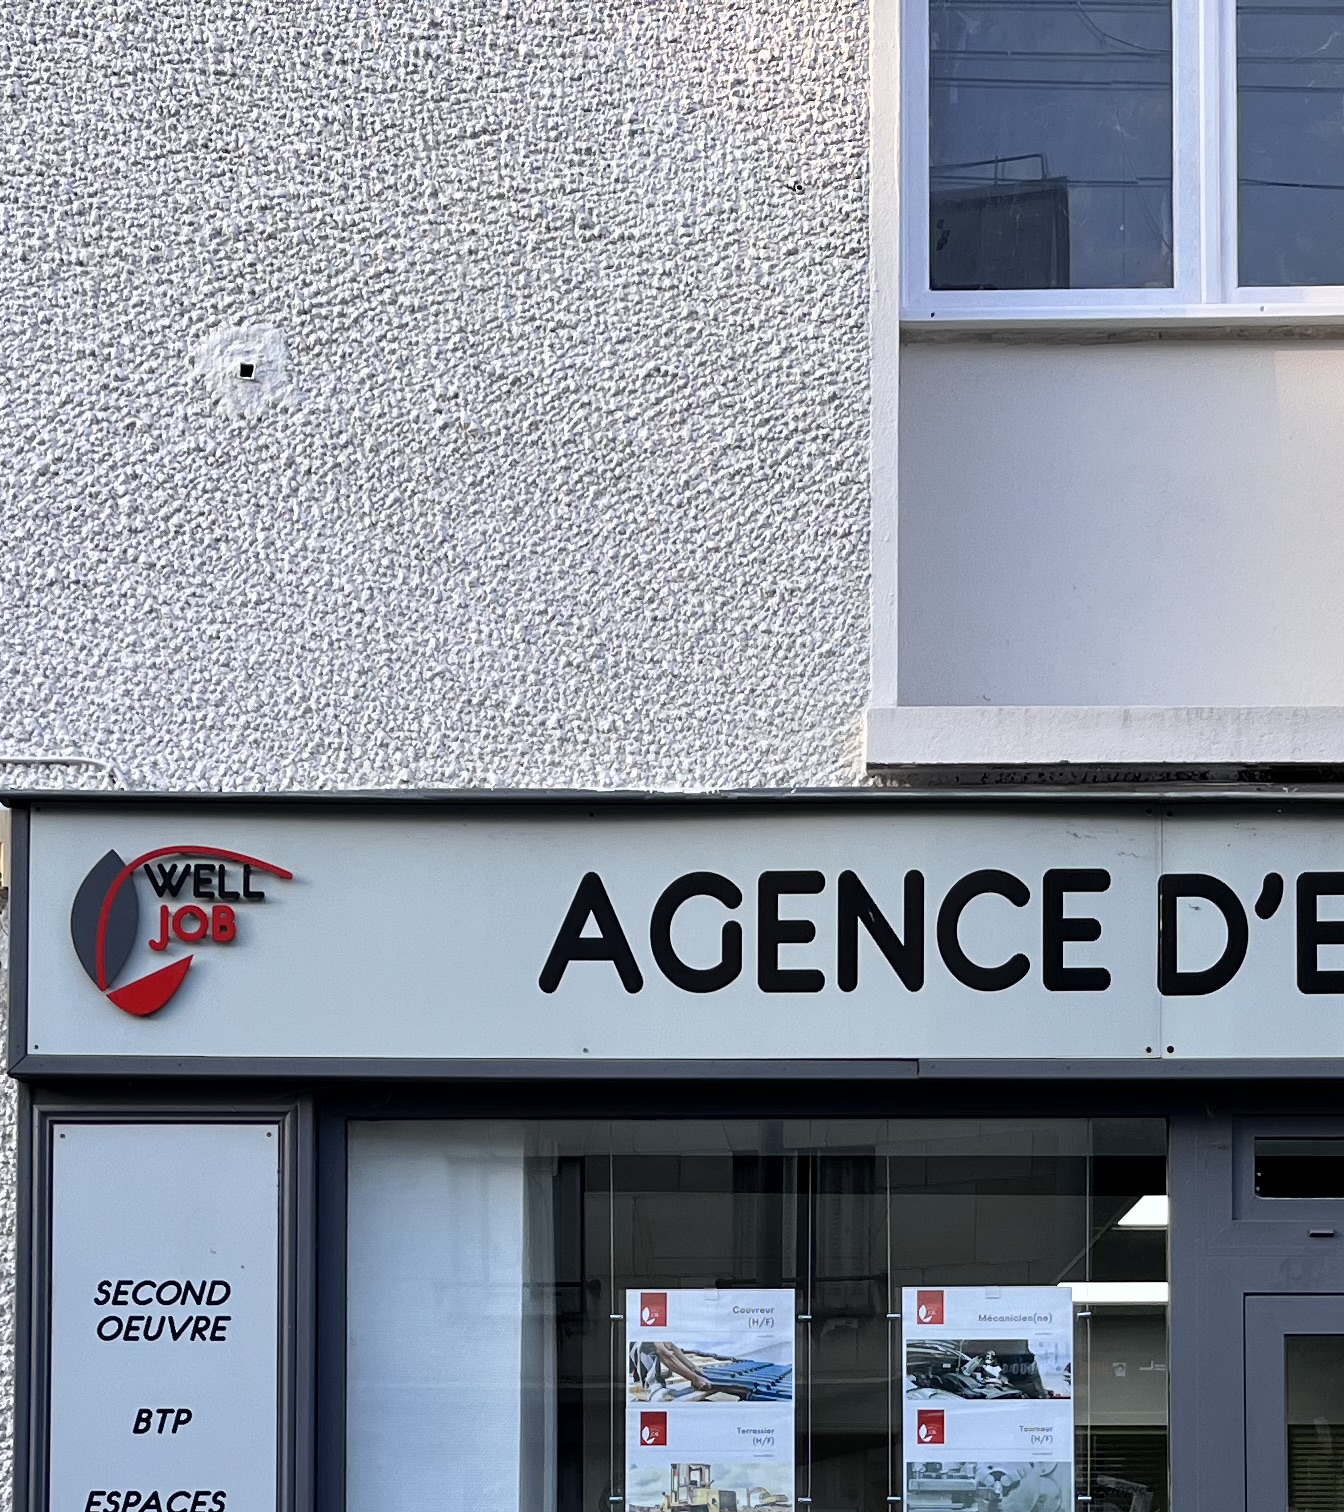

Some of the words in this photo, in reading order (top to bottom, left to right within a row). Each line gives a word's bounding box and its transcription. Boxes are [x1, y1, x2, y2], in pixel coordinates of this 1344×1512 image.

[144, 863, 265, 899] WELL
[148, 904, 237, 952] JOB
[539, 868, 1112, 994] AGENCE
[93, 1280, 232, 1307] SECOND
[732, 1306, 775, 1315] Couvreur
[748, 1317, 775, 1328] (H/F)
[978, 1313, 1053, 1324] Mécanicien(ne)
[96, 1315, 232, 1342] OEUVRE
[132, 1408, 193, 1435] BTP
